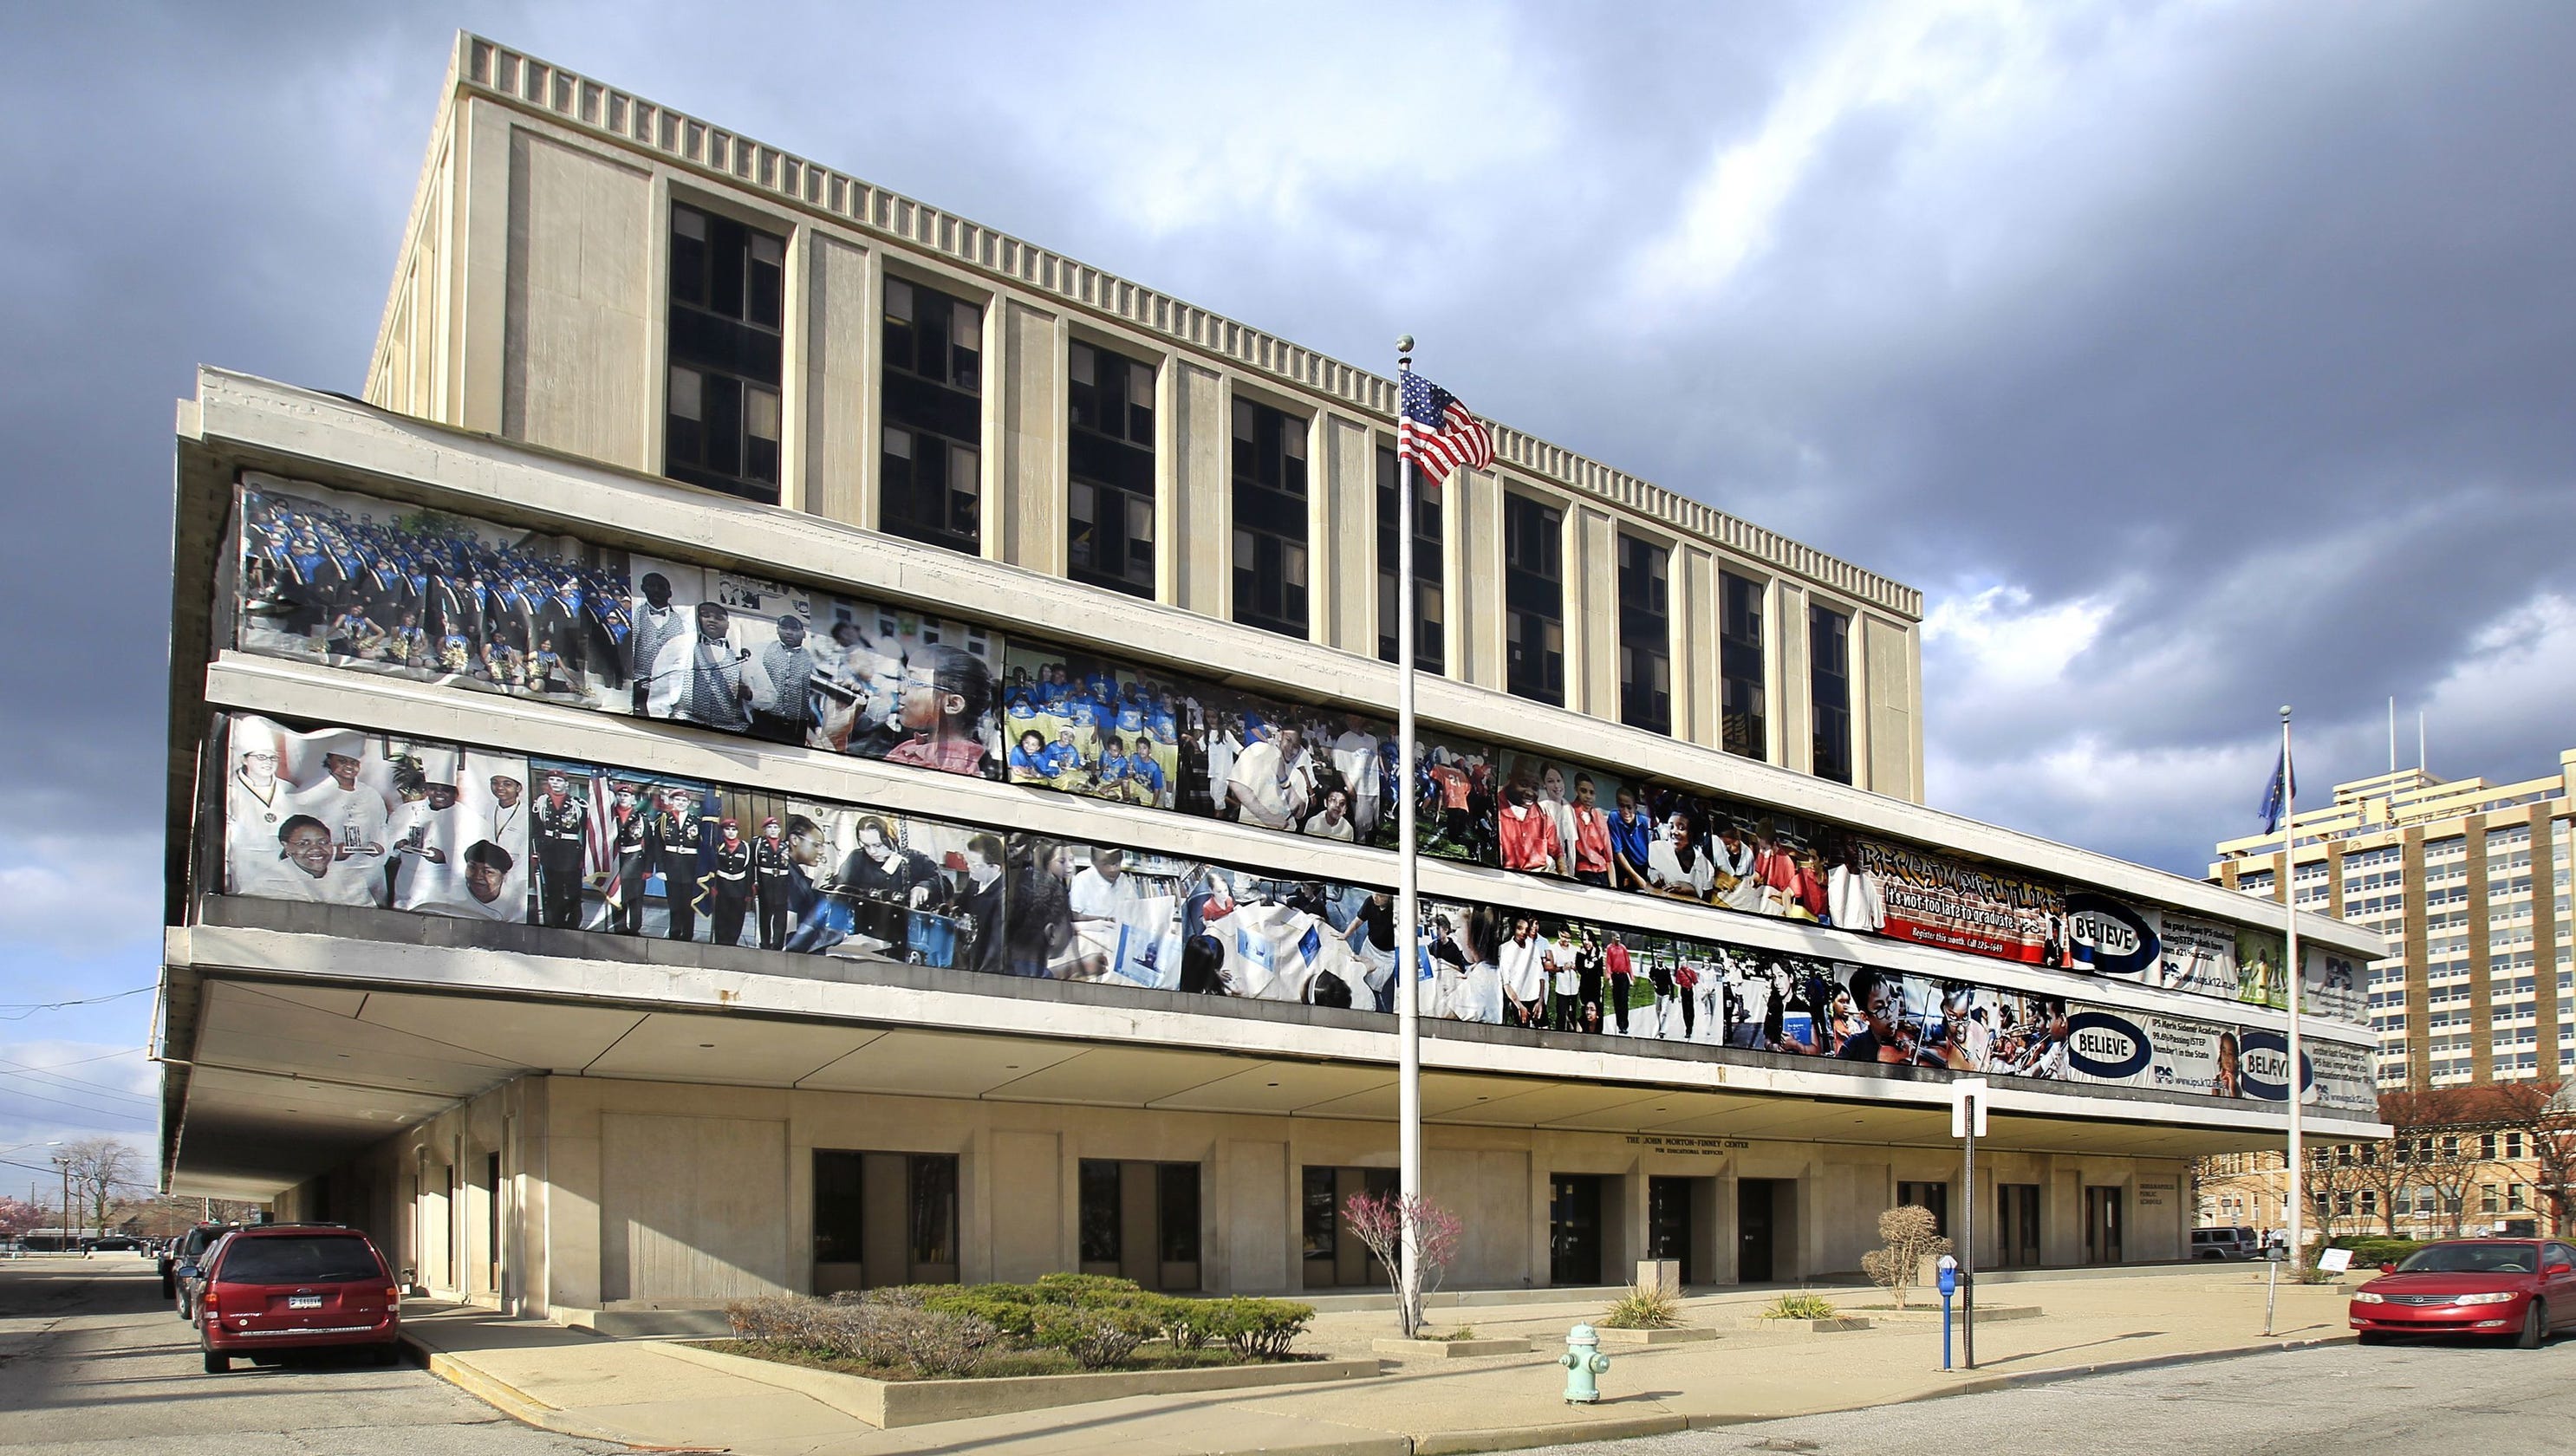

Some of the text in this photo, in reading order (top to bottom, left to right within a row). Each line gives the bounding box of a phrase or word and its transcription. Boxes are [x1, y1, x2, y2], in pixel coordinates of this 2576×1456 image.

[1858, 842, 1959, 893] RECLAIM
[1979, 873, 2064, 914] FUTURE
[1885, 886, 2015, 929] It's not too late to graduate
[1912, 926, 1935, 939] Register
[1935, 932, 1947, 942] this
[1967, 939, 1977, 947] Call
[2076, 917, 2132, 950] BELIEVE
[2079, 1033, 2129, 1056] BELIEVE
[2185, 1049, 2194, 1057] the
[2195, 1050, 2209, 1059] State
[2248, 1054, 2288, 1078] BELIEV
[1643, 1136, 1662, 1145] JOHN
[1666, 1137, 1721, 1147] MORTON-FINNEY
[1724, 1141, 1749, 1149] CENTER
